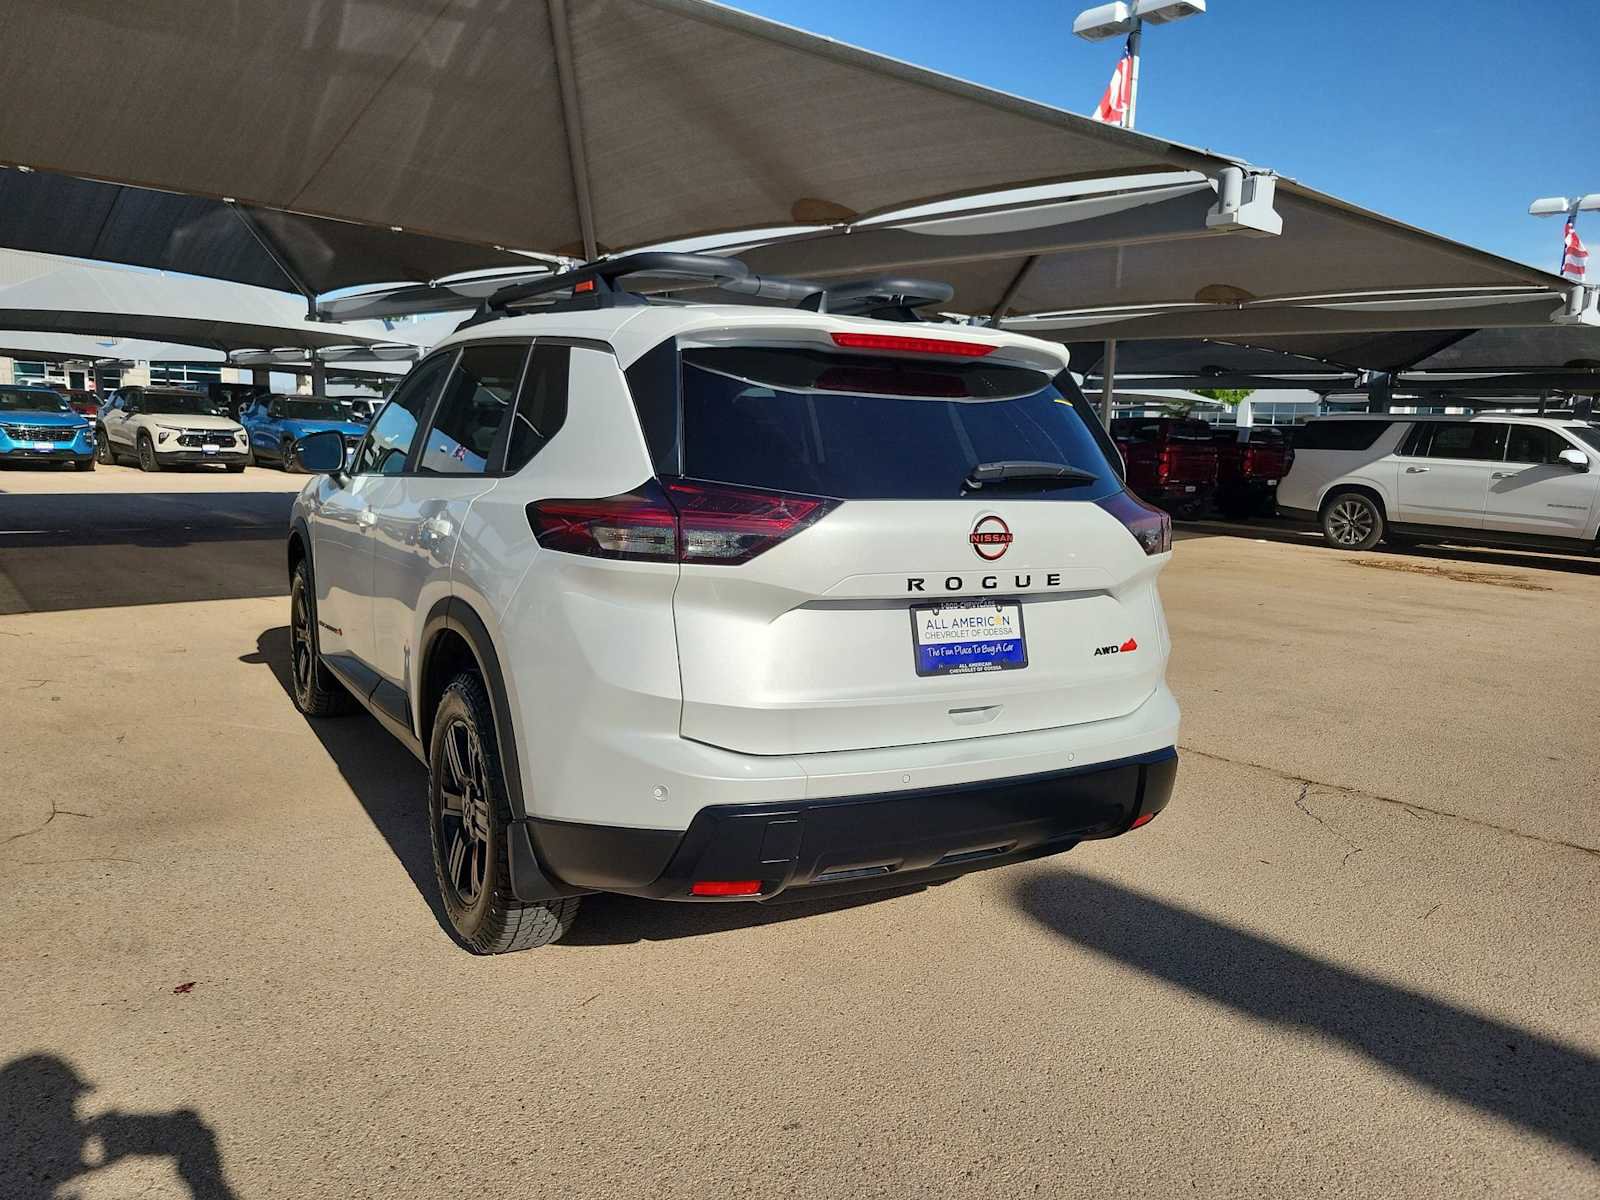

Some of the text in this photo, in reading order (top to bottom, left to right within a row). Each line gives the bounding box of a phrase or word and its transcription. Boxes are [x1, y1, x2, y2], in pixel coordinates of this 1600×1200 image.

[970, 533, 1014, 543] NISSAN
[907, 573, 1061, 592] ROGUE
[926, 619, 948, 630] ALL
[925, 630, 969, 639] CHEVROLET
[984, 627, 1013, 637] ODESSA
[927, 647, 940, 657] The
[940, 646, 954, 657] Fun
[954, 645, 972, 656] Place
[972, 644, 982, 653] To
[981, 643, 996, 655] Buy
[995, 643, 1002, 652] A
[1094, 645, 1119, 657] AWD
